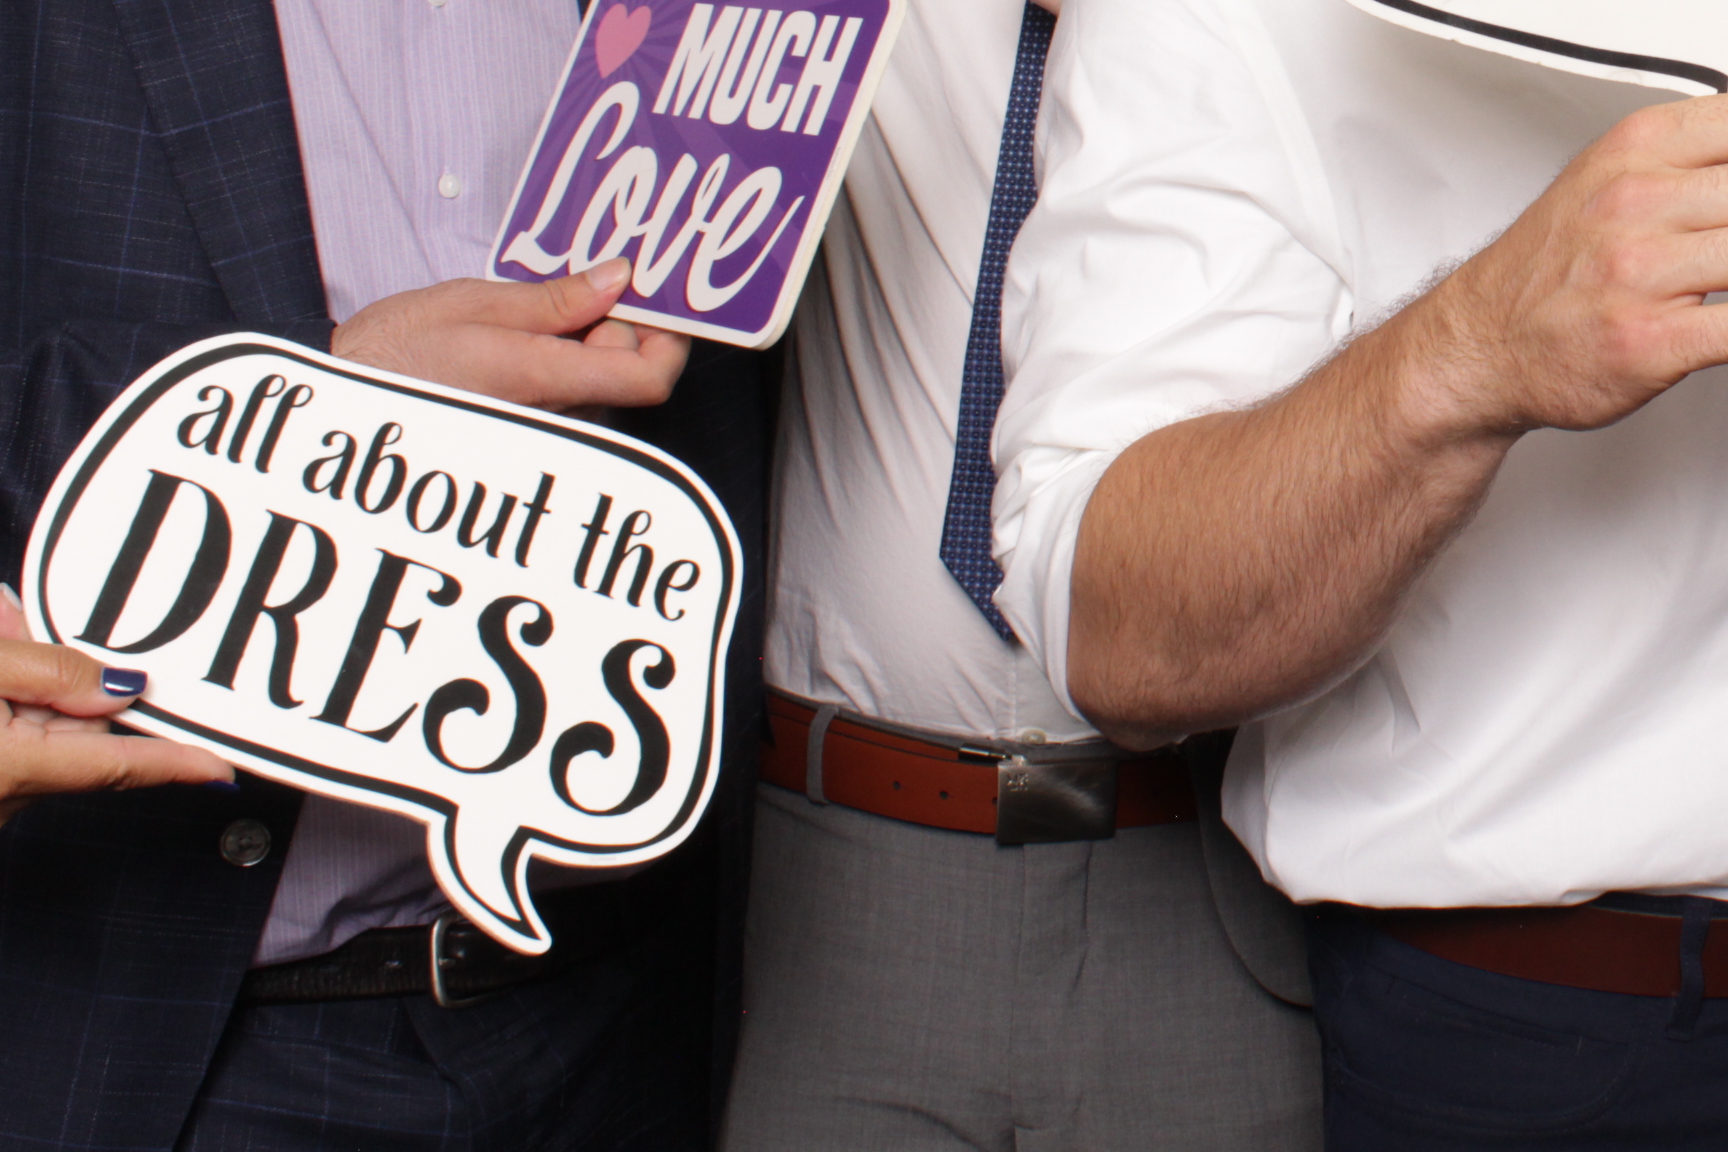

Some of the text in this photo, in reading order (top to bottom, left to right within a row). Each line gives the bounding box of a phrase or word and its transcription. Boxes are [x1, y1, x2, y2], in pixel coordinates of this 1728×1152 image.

[652, 2, 864, 136] MUCH
[500, 80, 806, 312] Love
[177, 374, 700, 620] all about the
[73, 468, 676, 817] DRESS
